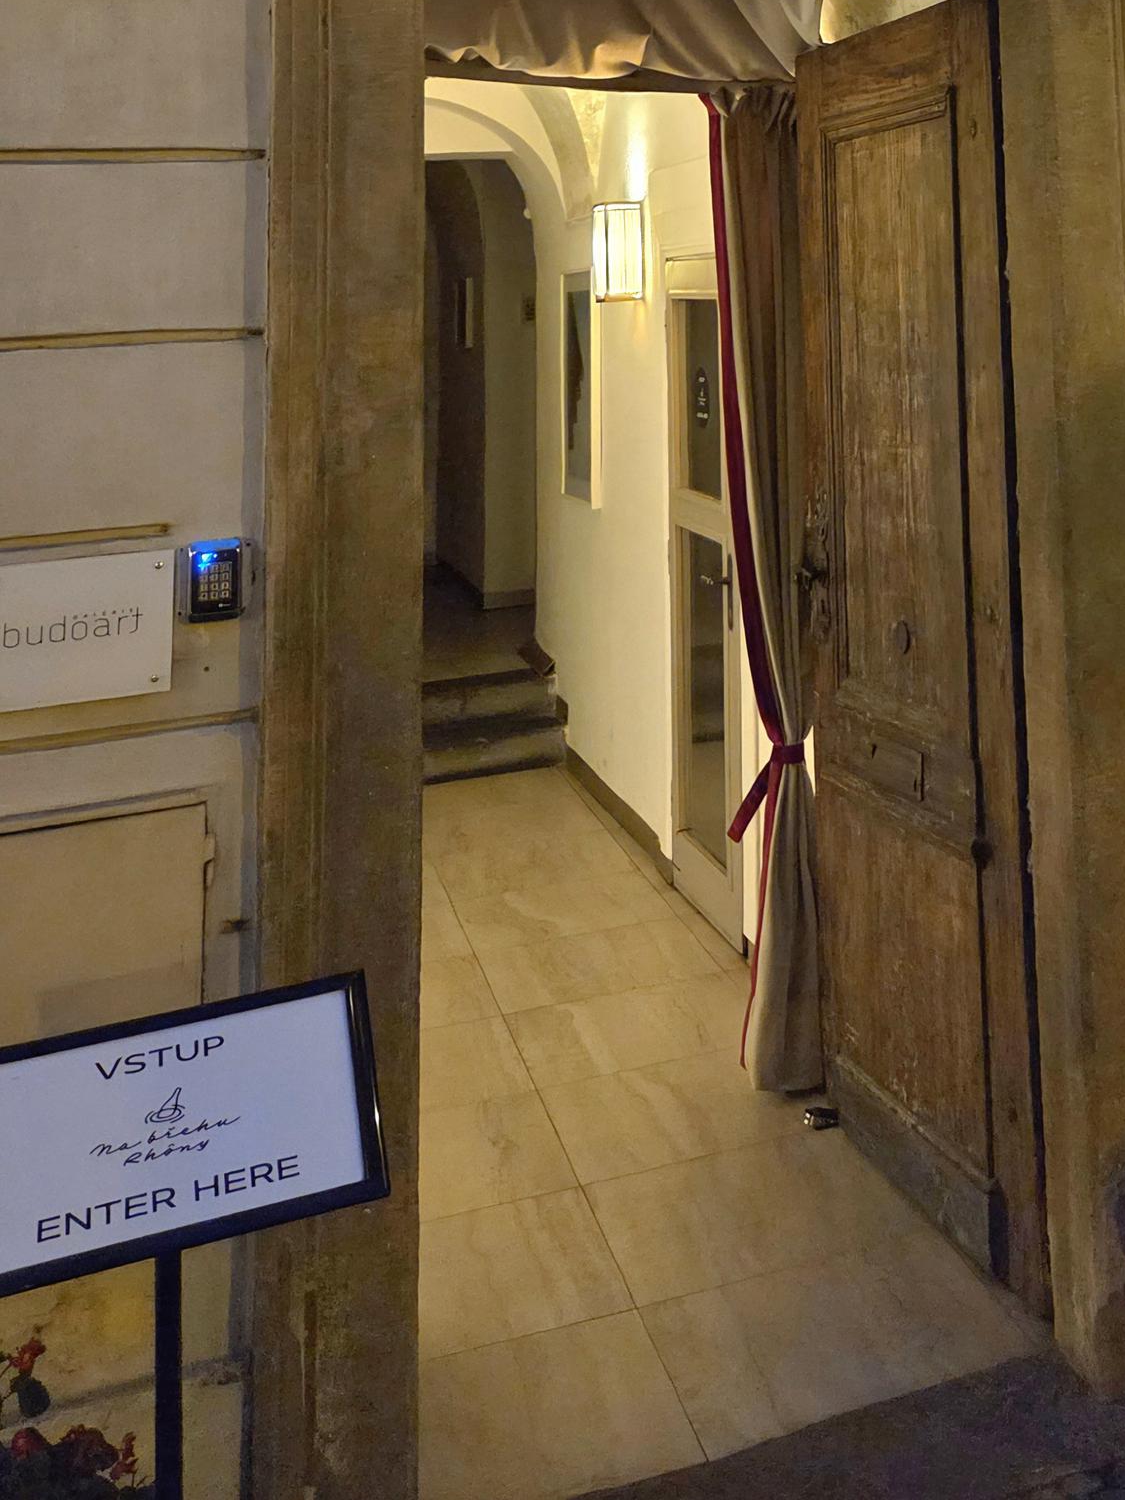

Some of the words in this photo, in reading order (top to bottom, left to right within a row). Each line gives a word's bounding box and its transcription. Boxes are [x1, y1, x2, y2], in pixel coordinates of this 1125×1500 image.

[95, 1035, 225, 1080] VSTUP
[147, 1116, 241, 1144] břehu
[123, 1139, 210, 1167] Rhôny
[36, 1186, 176, 1244] ENTER
[193, 1154, 301, 1202] HERE
